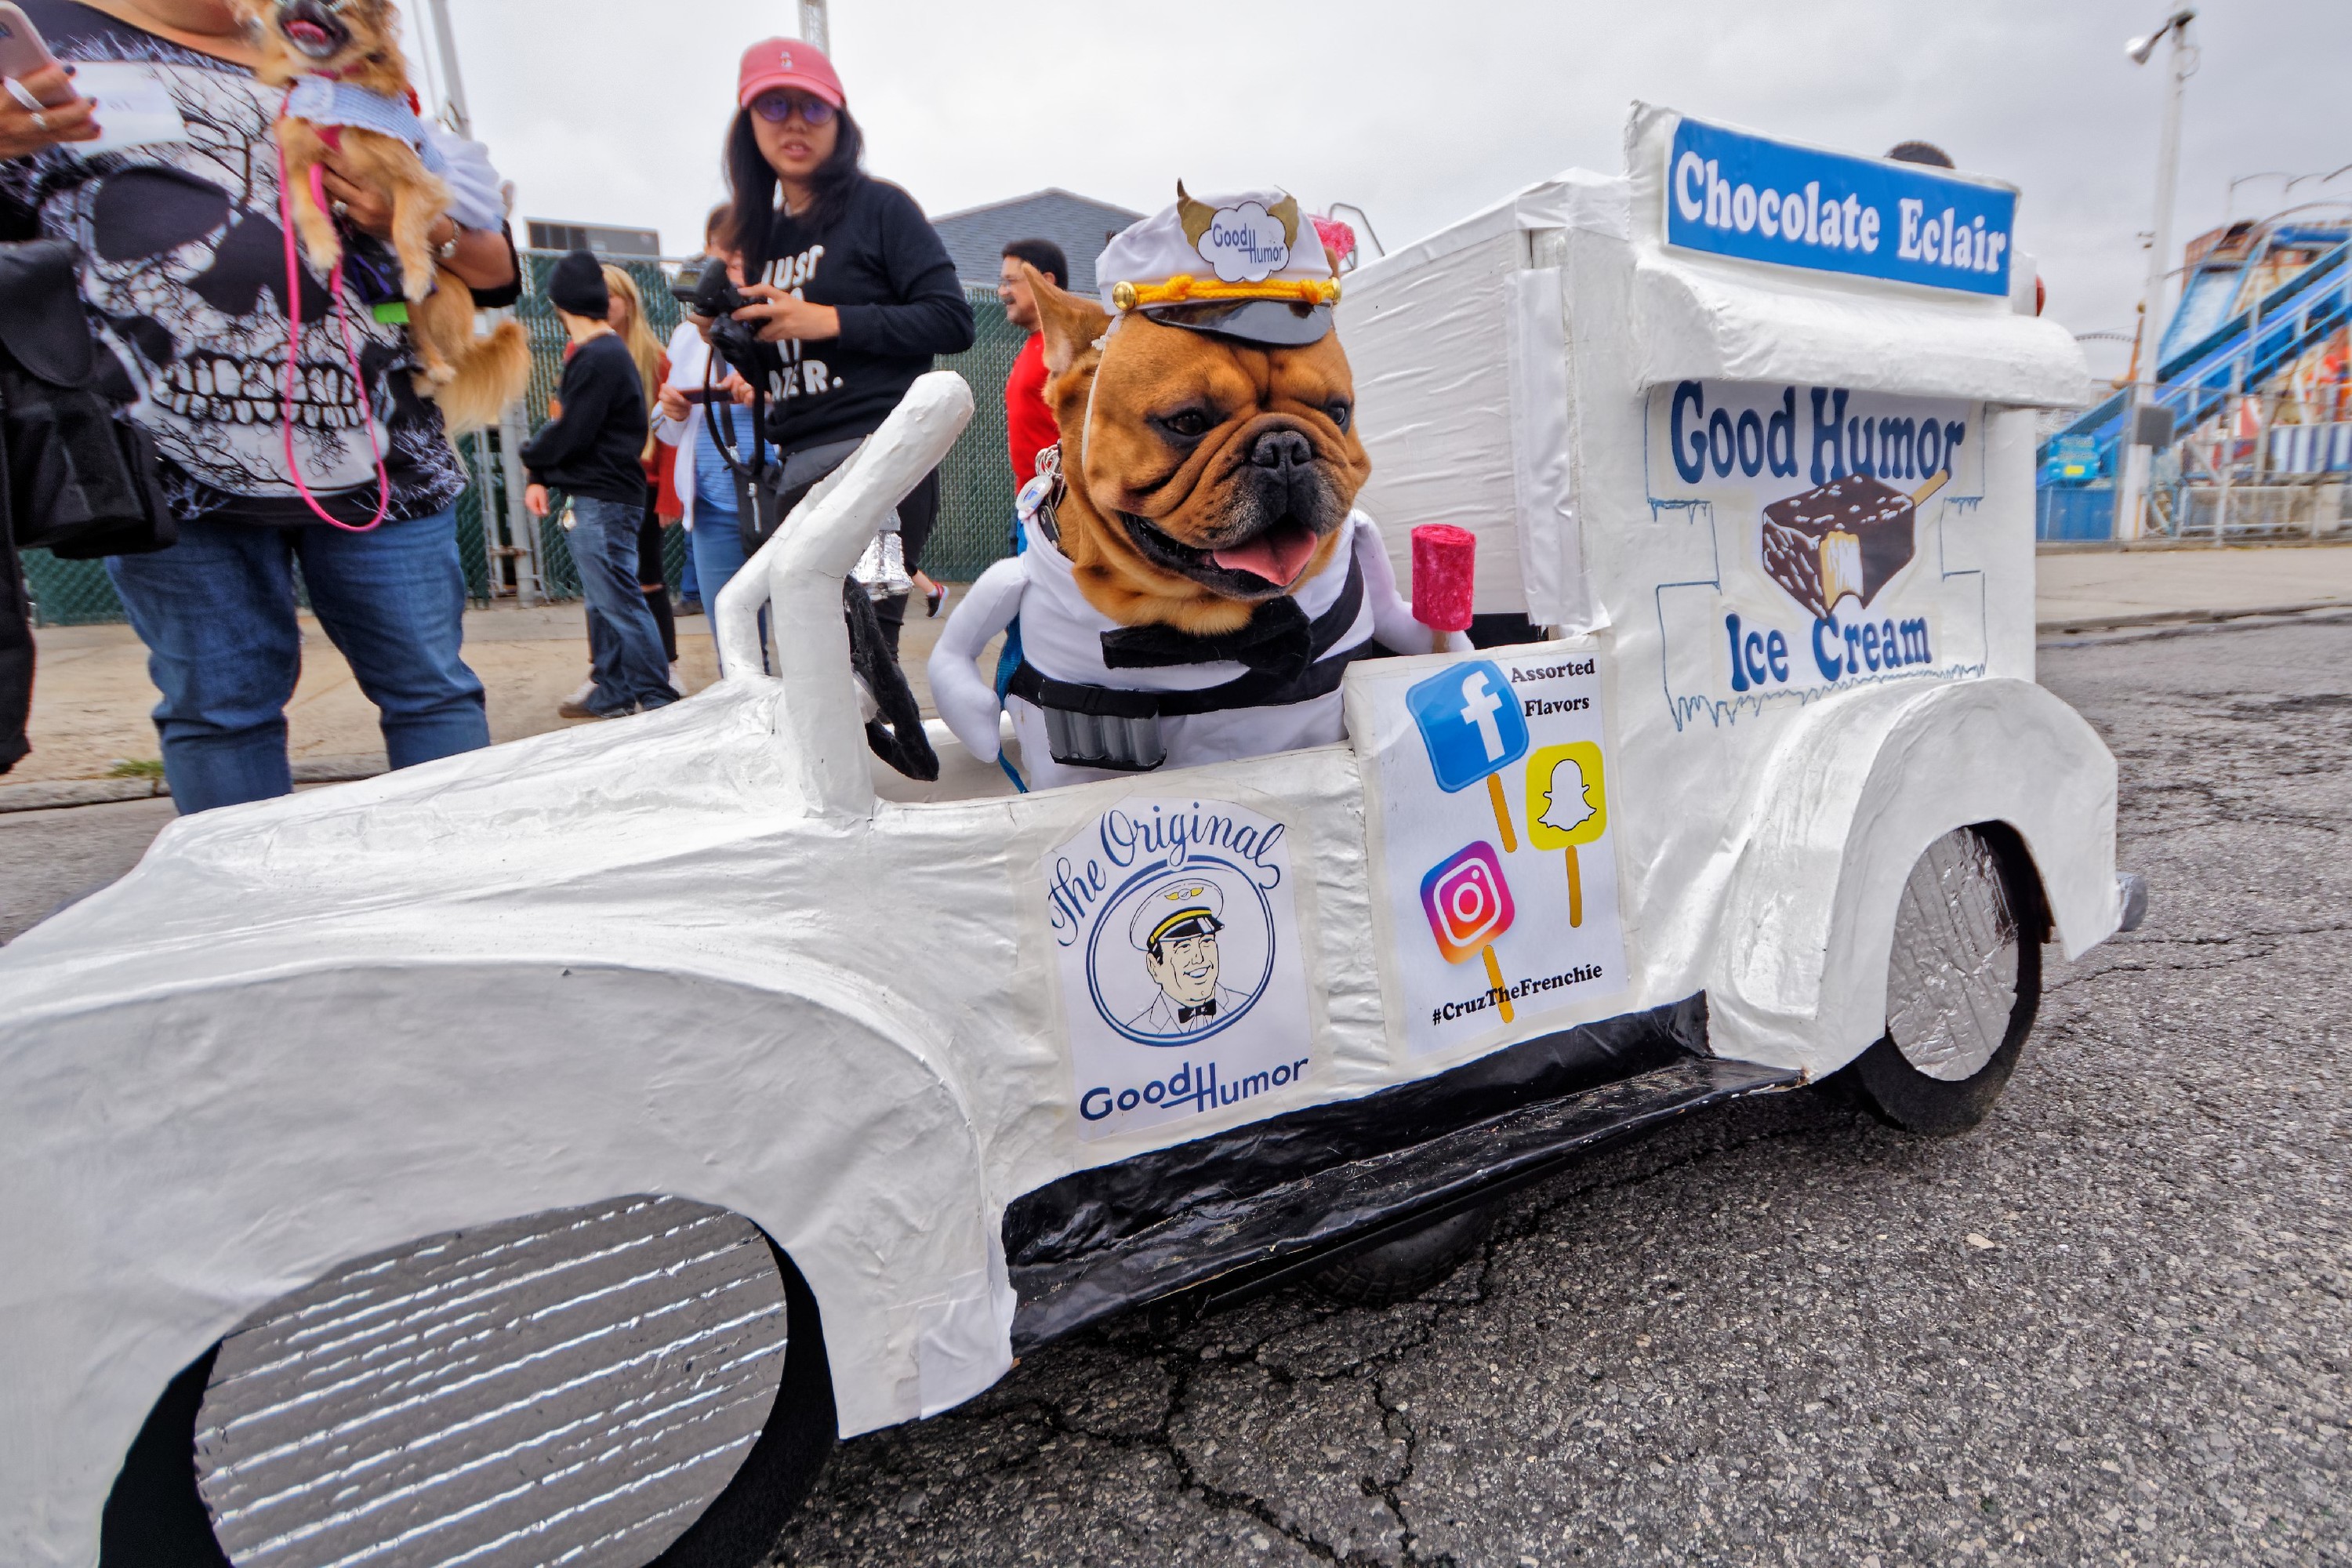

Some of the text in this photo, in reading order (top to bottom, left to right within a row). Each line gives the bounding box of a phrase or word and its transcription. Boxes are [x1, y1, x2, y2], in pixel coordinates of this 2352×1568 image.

[1212, 222, 1284, 264] Good Humor
[1676, 151, 2006, 273] Chocolate Eclair
[1671, 379, 1965, 486] Good Humor
[1511, 658, 1596, 684] Assorted
[1726, 613, 1933, 691] Ice Cream
[1524, 696, 1590, 717] Flavors
[1047, 801, 1285, 947] The Original
[1432, 964, 1603, 1026] #CruzTheFrenchie
